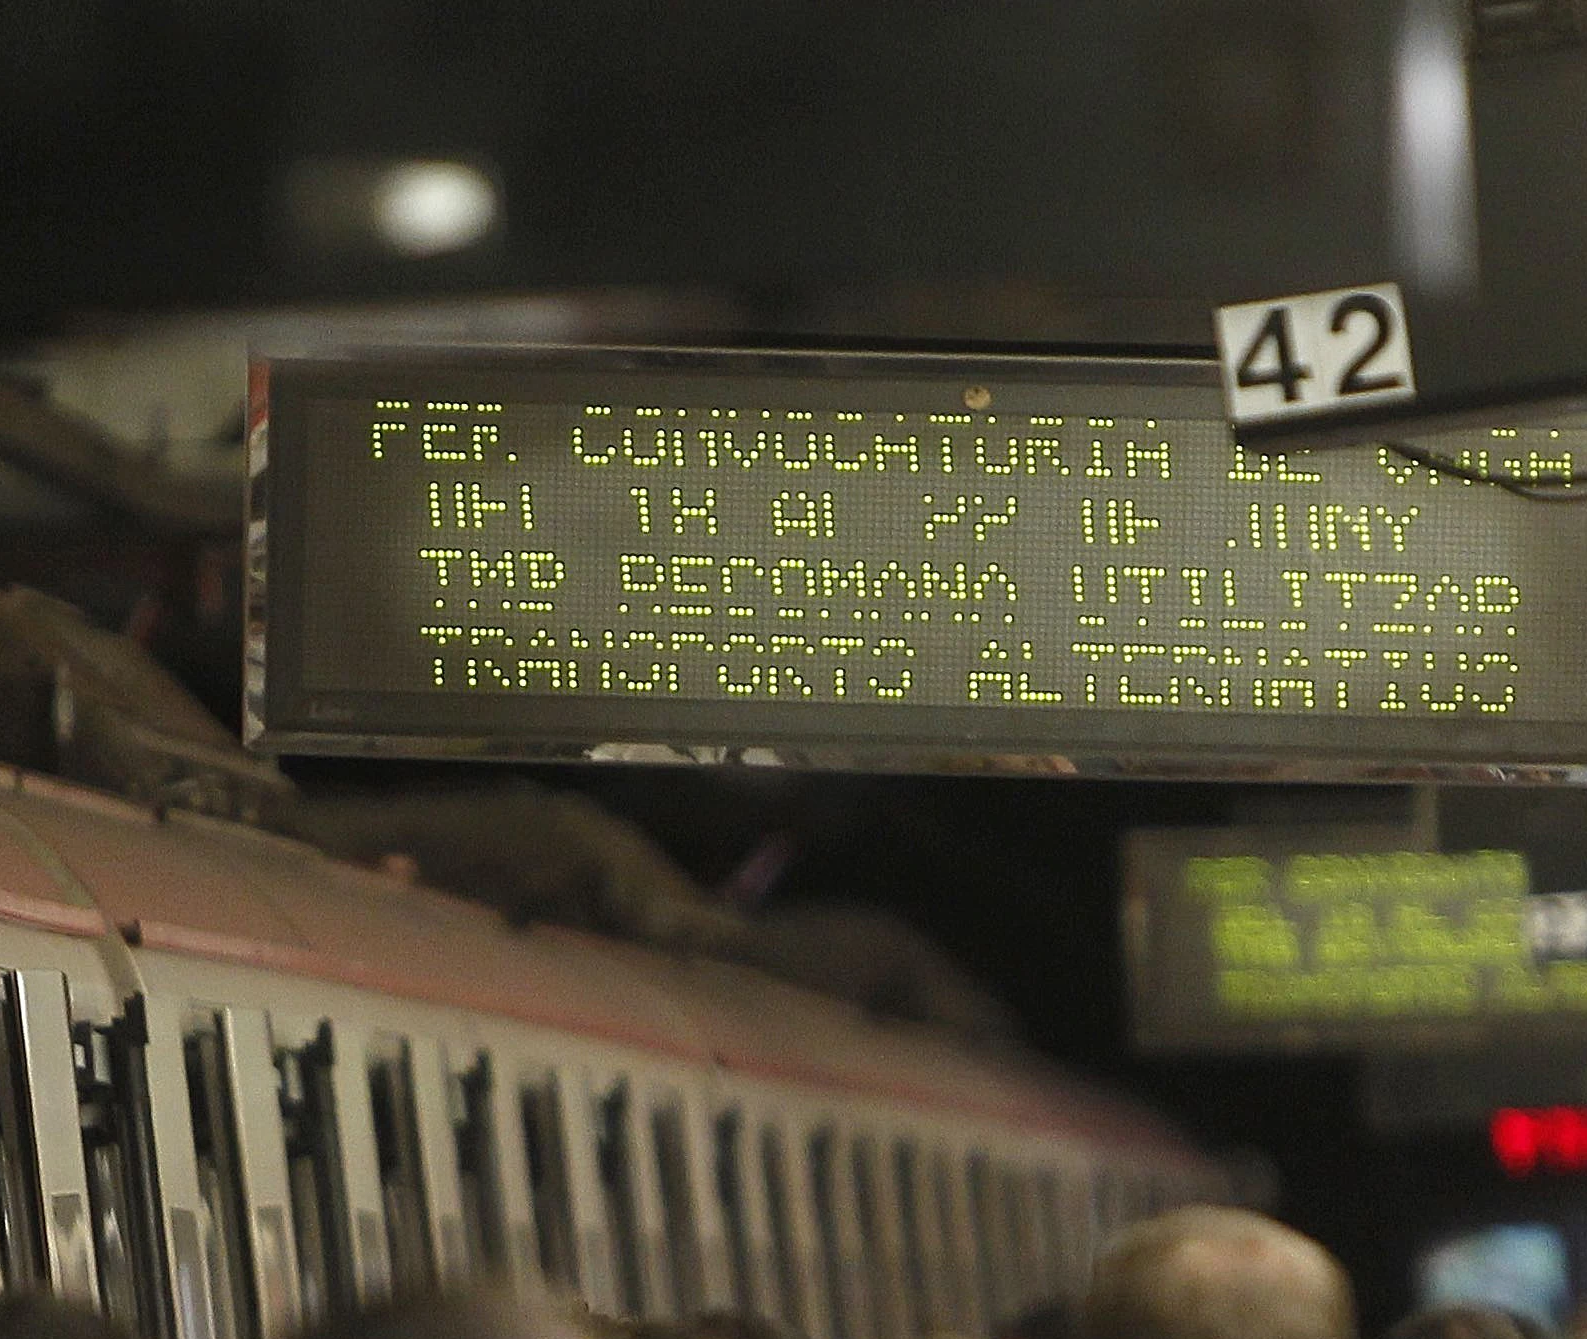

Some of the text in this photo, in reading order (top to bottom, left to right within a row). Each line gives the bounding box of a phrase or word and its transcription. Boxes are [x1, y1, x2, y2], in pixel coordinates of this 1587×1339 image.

[1236, 293, 1408, 402] 42
[420, 549, 1519, 636] TMB RECOMANA UTILITZAR
[420, 627, 1518, 712] TRANSPORTS ALTERNATIUS
